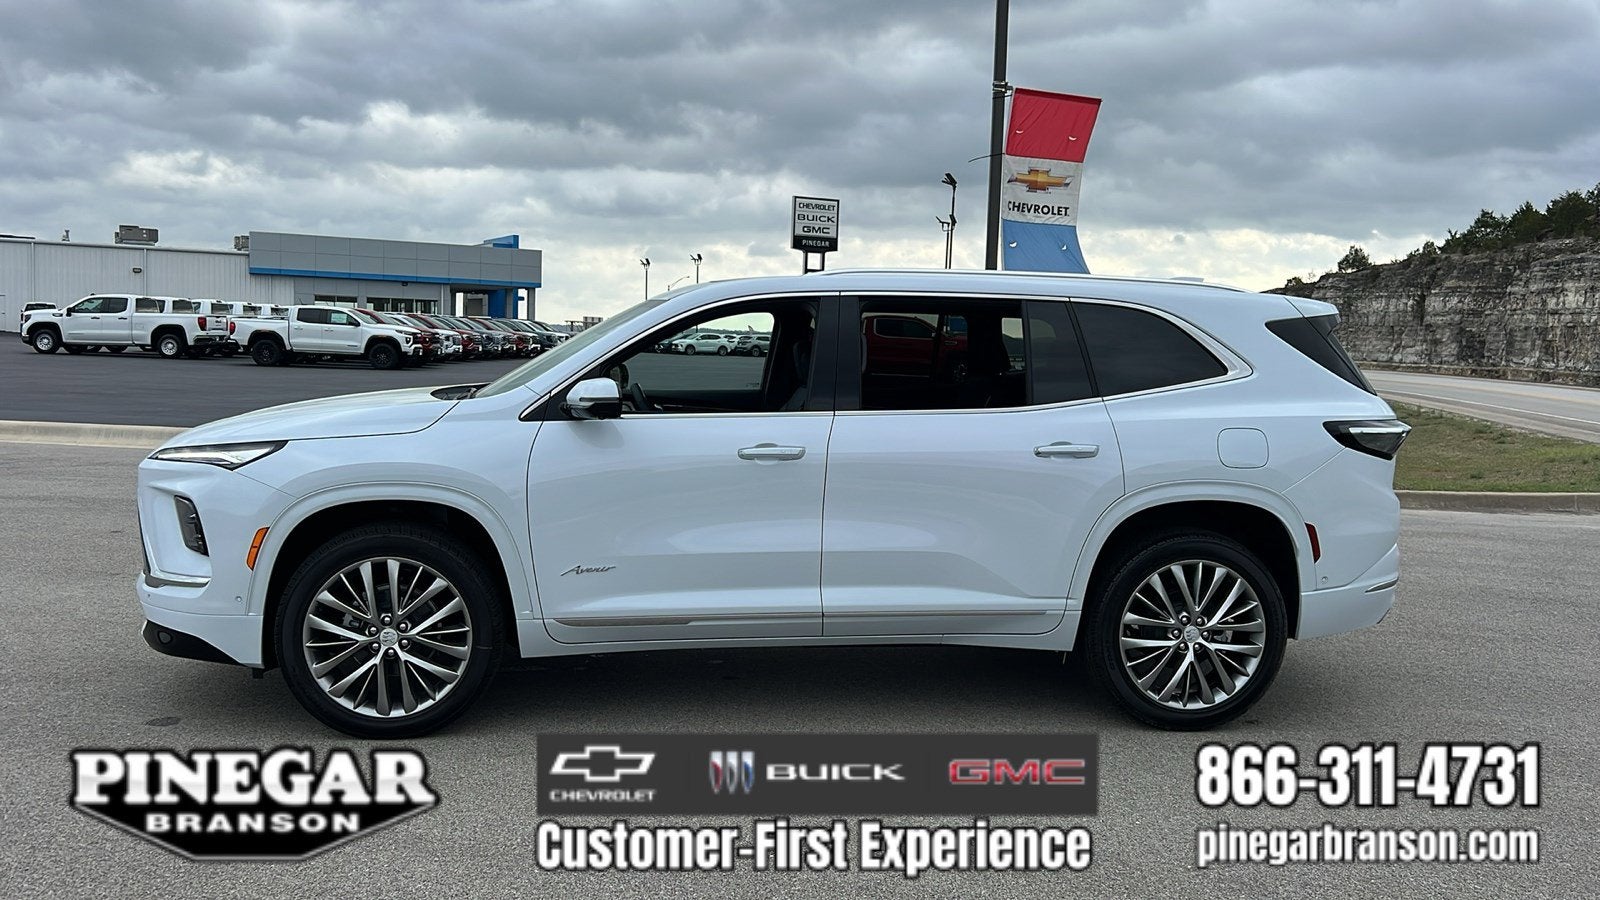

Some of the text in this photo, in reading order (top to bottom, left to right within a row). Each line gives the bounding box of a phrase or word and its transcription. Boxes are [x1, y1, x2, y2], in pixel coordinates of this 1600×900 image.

[798, 202, 836, 212] CHEVROLET
[1008, 201, 1070, 217] CHEVROLET
[797, 213, 836, 224] BUICK
[802, 225, 831, 235] GMC
[802, 239, 830, 248] PINEGAR
